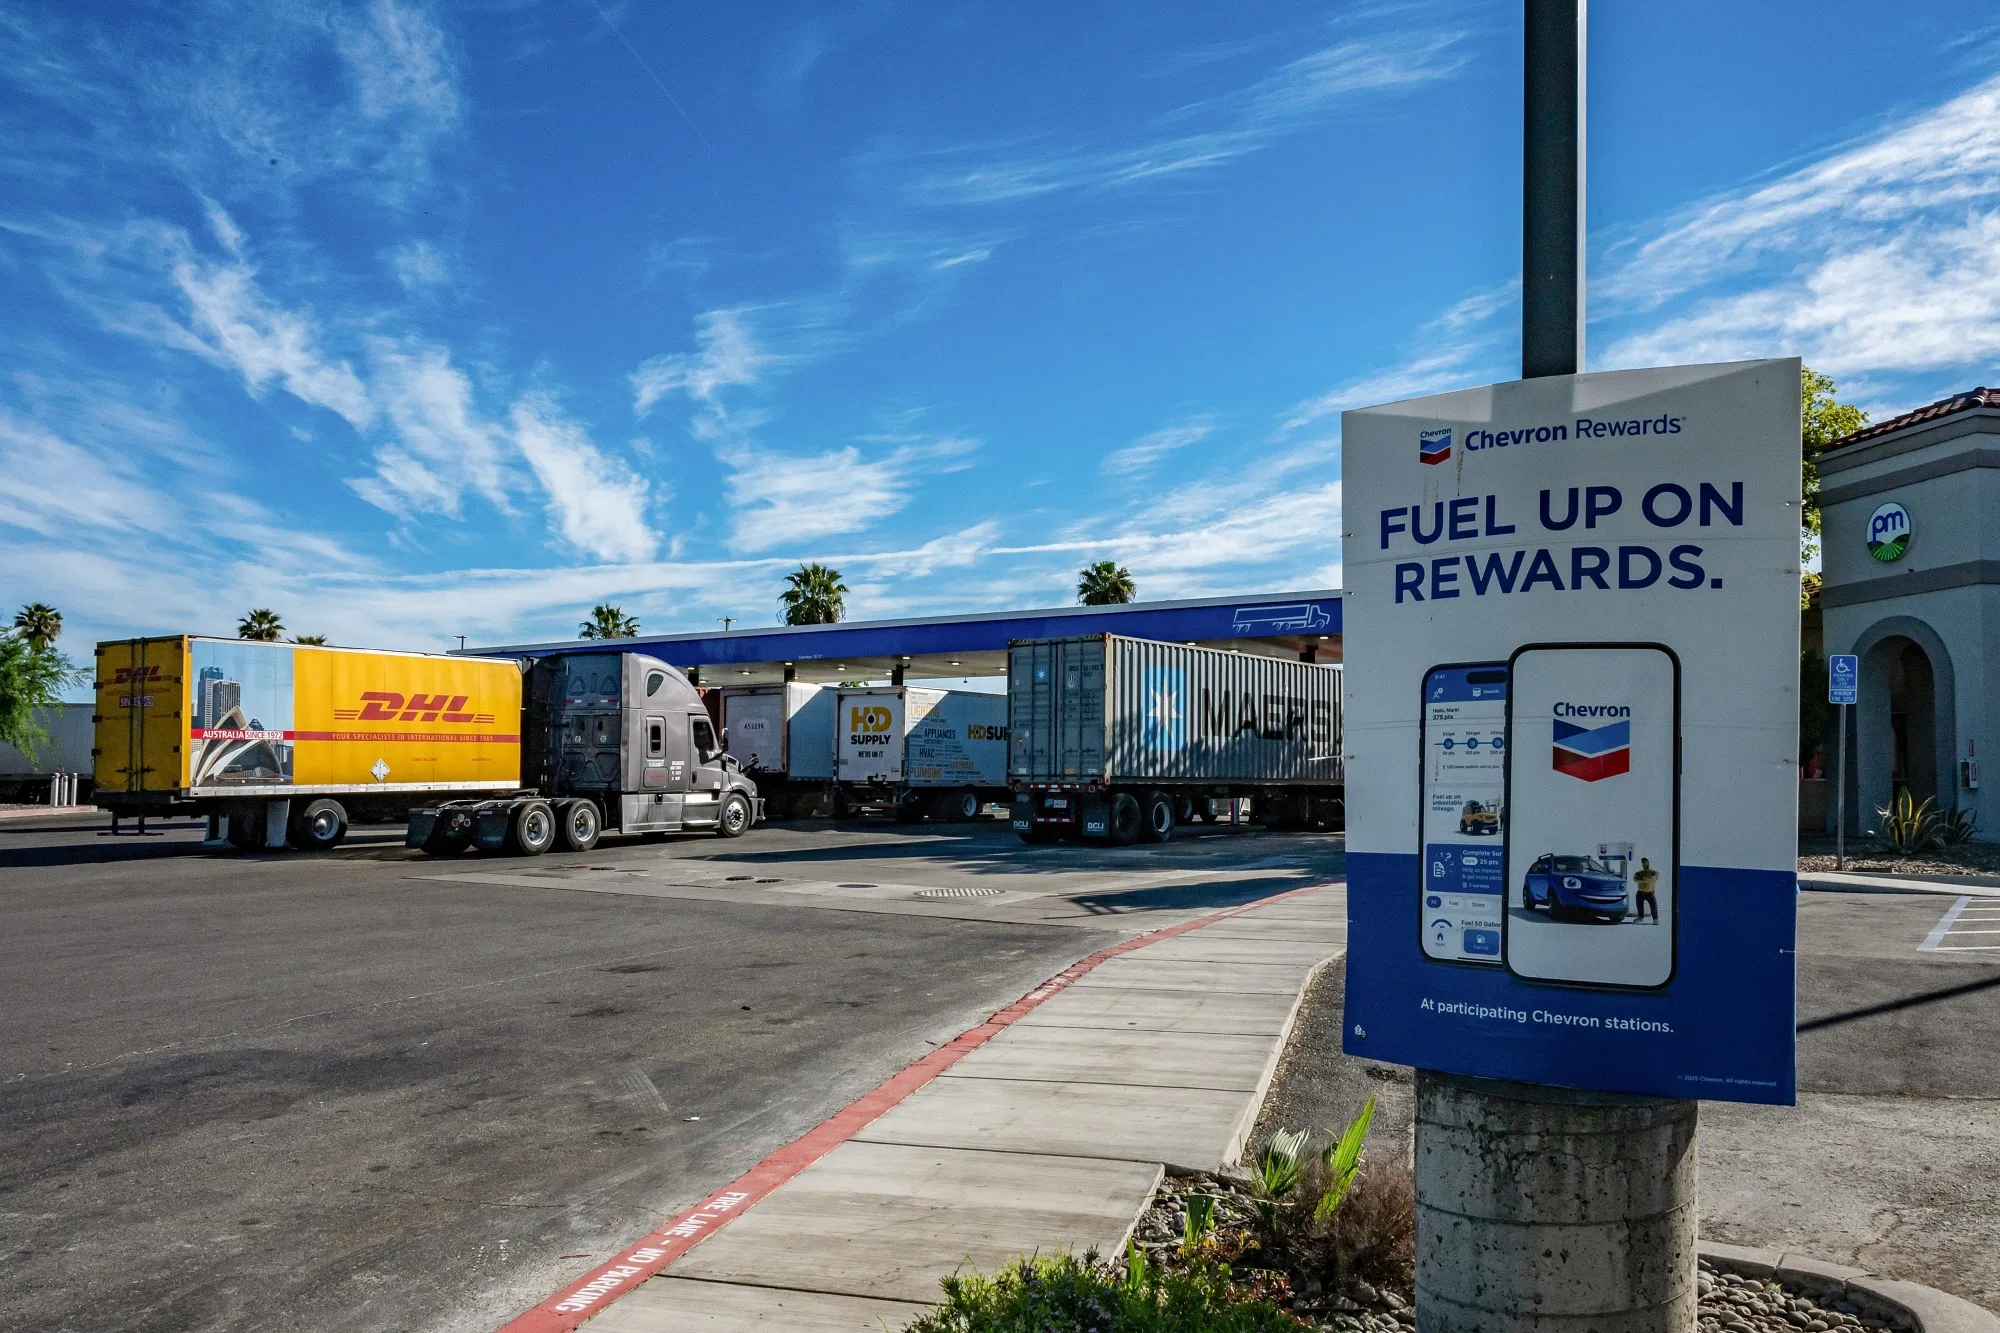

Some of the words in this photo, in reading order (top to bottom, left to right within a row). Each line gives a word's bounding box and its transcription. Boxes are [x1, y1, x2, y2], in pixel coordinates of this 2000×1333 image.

[1420, 428, 1452, 438] Chevron
[1466, 424, 1568, 450] Chevron
[1381, 494, 1516, 550] FUEL
[1539, 486, 1622, 531] UP
[1642, 482, 1744, 528] ON
[1872, 510, 1904, 546] pm
[1395, 545, 1724, 604] REWARDS.
[120, 697, 137, 708] SINE
[358, 692, 475, 722] DHL
[1553, 702, 1631, 717] Chevron
[851, 706, 892, 732] HD
[203, 730, 244, 739] AUSTRALIA
[851, 735, 891, 744] SUPPLY
[924, 728, 956, 739] APPLIANCES
[920, 748, 935, 758] HVAC
[1421, 998, 1434, 1010] At
[1438, 1001, 1527, 1023] participating
[1532, 1010, 1599, 1027] Chevron
[1605, 1017, 1674, 1033] stations.
[704, 1191, 749, 1212] FIRE
[664, 1213, 718, 1238] LANE
[628, 1247, 666, 1263] NO
[556, 1265, 642, 1312] PARKING
